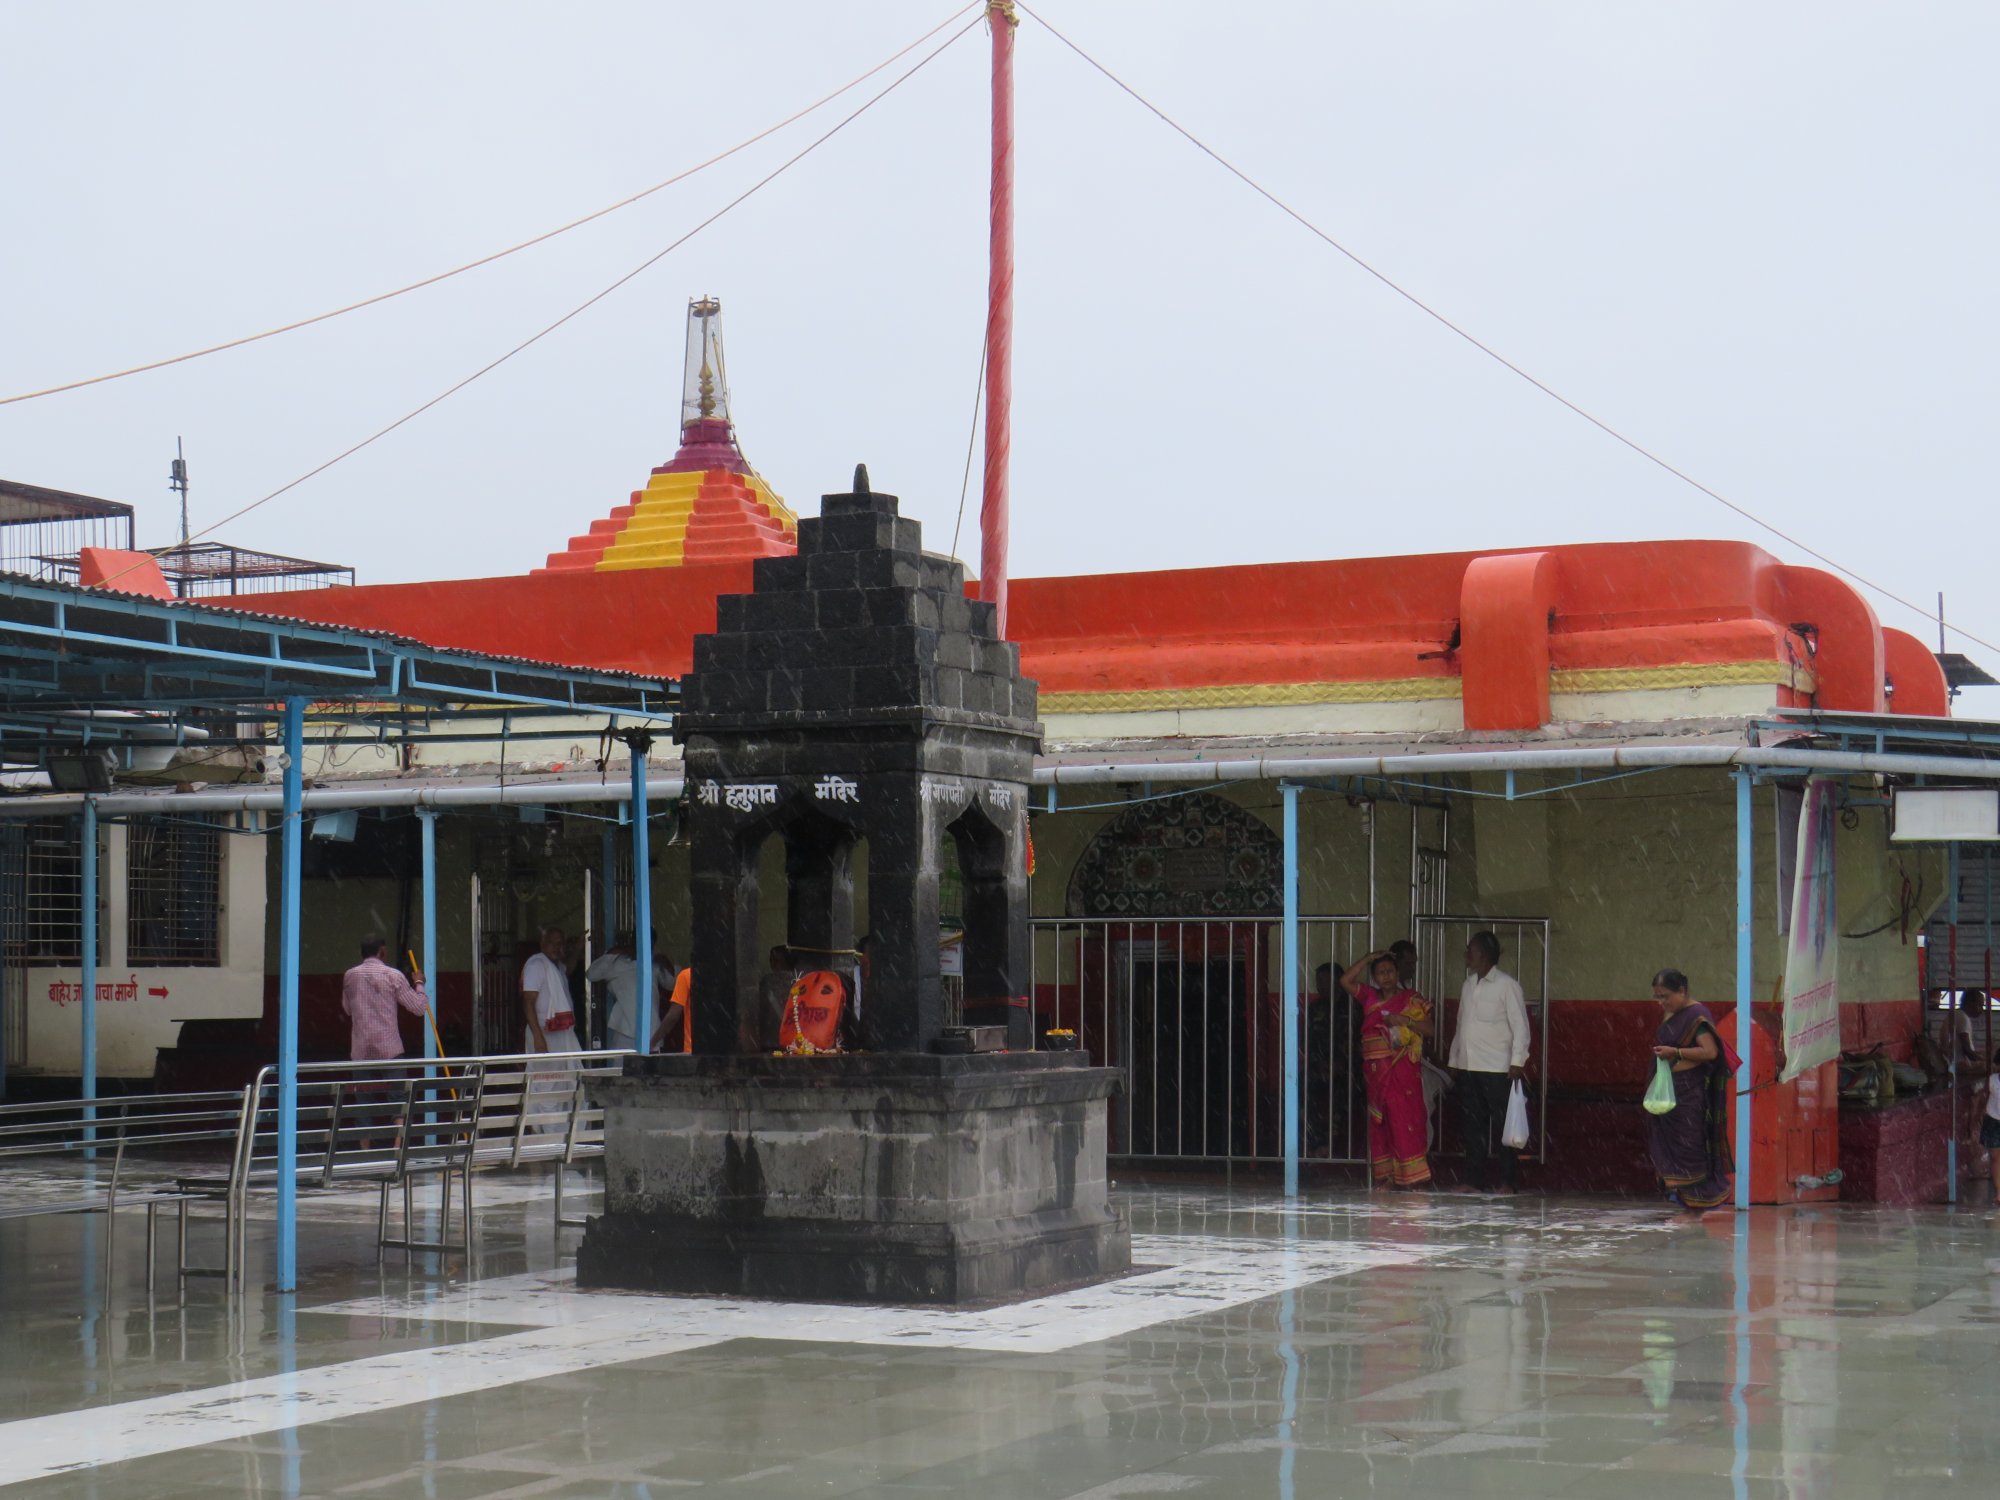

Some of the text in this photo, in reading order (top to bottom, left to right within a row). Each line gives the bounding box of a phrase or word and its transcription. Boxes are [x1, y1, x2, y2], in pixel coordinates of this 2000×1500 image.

[697, 775, 860, 812] श्री हनुमान मंदिर
[920, 776, 932, 803] श्री
[989, 781, 1011, 811] मंदिर
[48, 980, 71, 1007] बाहेर
[115, 974, 138, 1001] मार्ग
